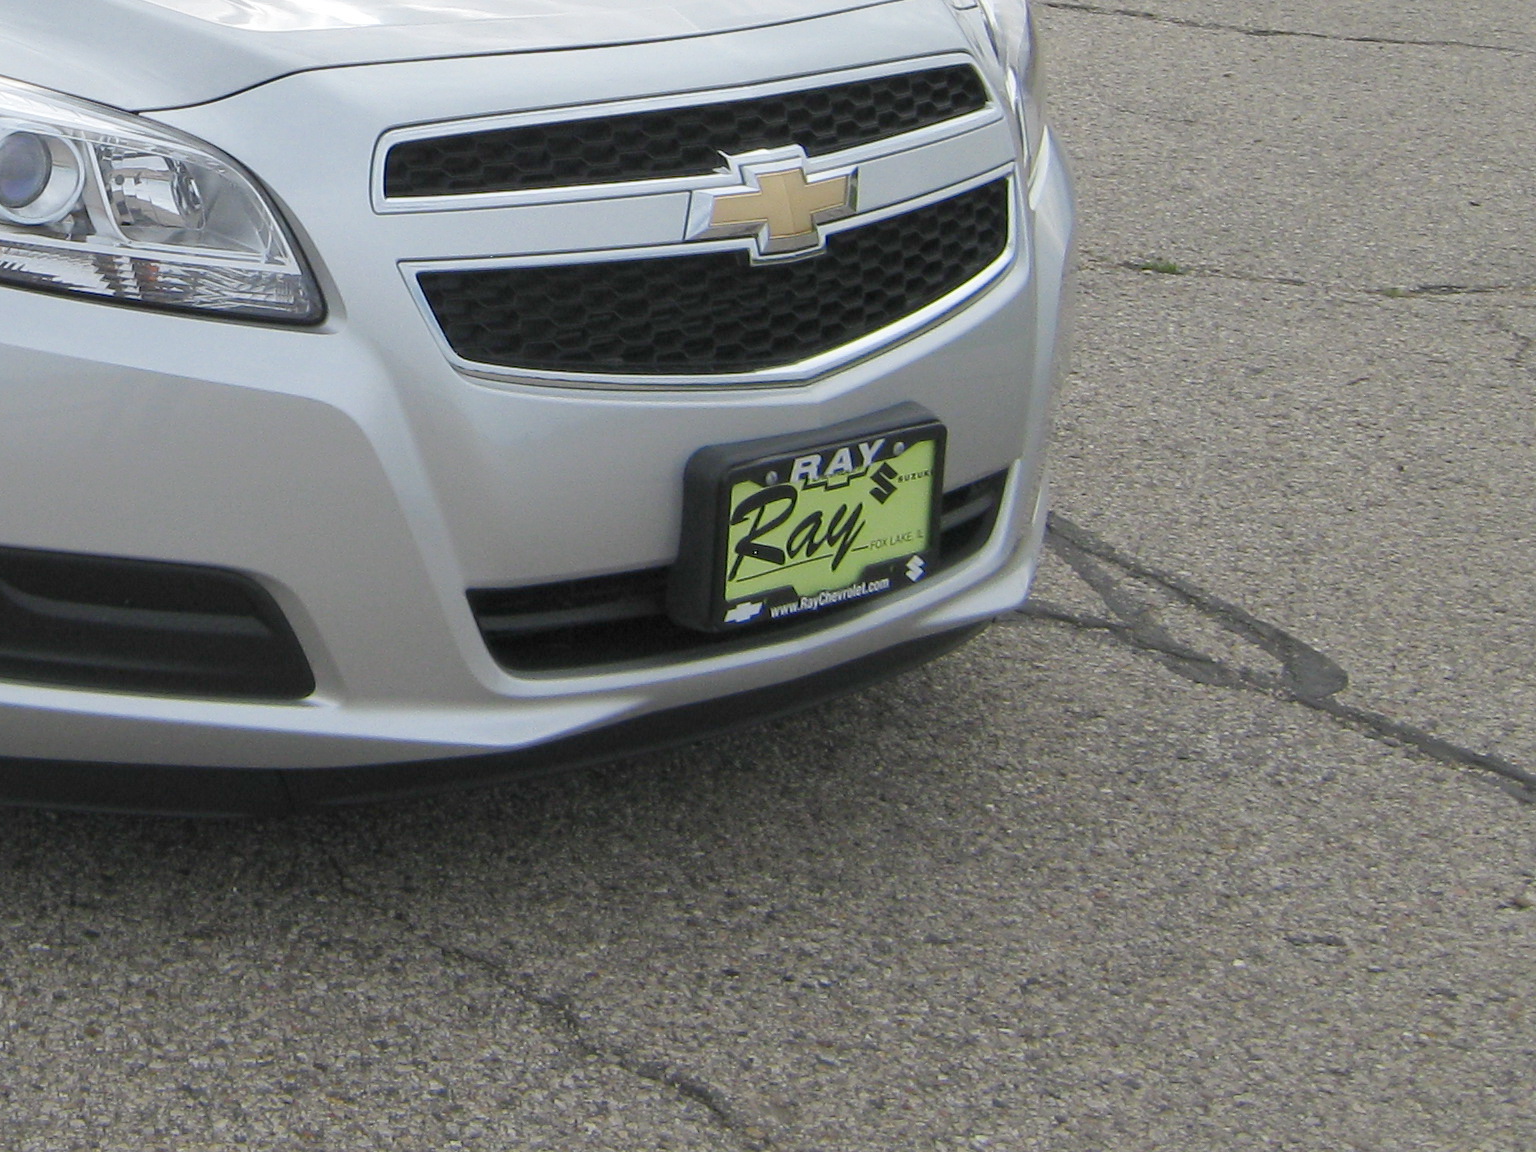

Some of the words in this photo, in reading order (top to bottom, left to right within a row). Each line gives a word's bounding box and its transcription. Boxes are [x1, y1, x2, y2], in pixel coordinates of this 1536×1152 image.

[790, 437, 887, 483] RAY
[727, 485, 866, 582] Ray
[870, 538, 890, 550] FOX
[890, 531, 912, 546] LAKE
[770, 578, 890, 618] www.RayChevrolet.com
